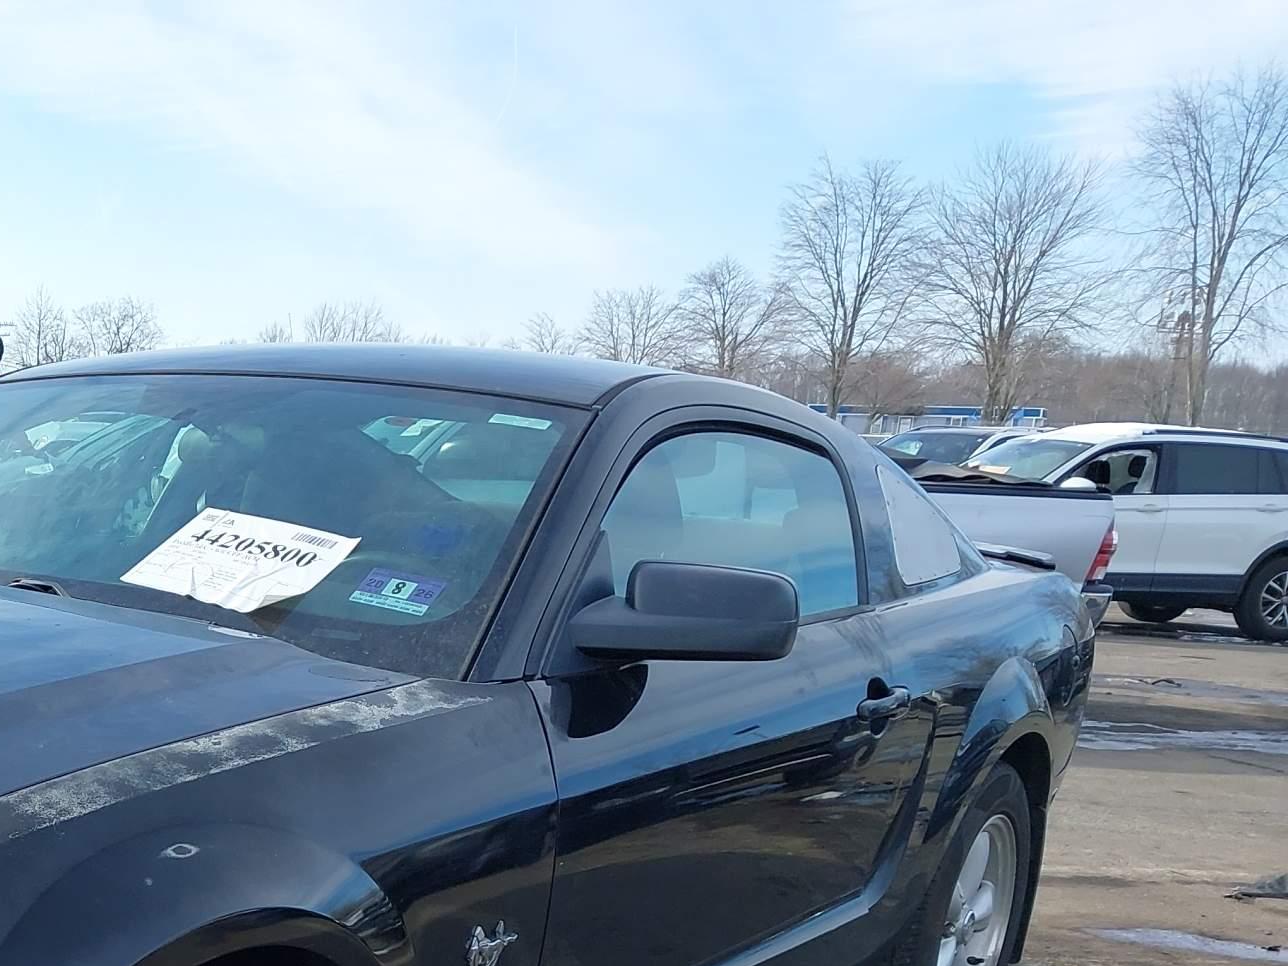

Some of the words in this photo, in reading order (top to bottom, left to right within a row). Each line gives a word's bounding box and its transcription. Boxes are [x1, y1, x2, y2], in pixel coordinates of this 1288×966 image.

[191, 529, 318, 568] 44205800
[366, 578, 385, 589] 20
[392, 581, 407, 595] 8
